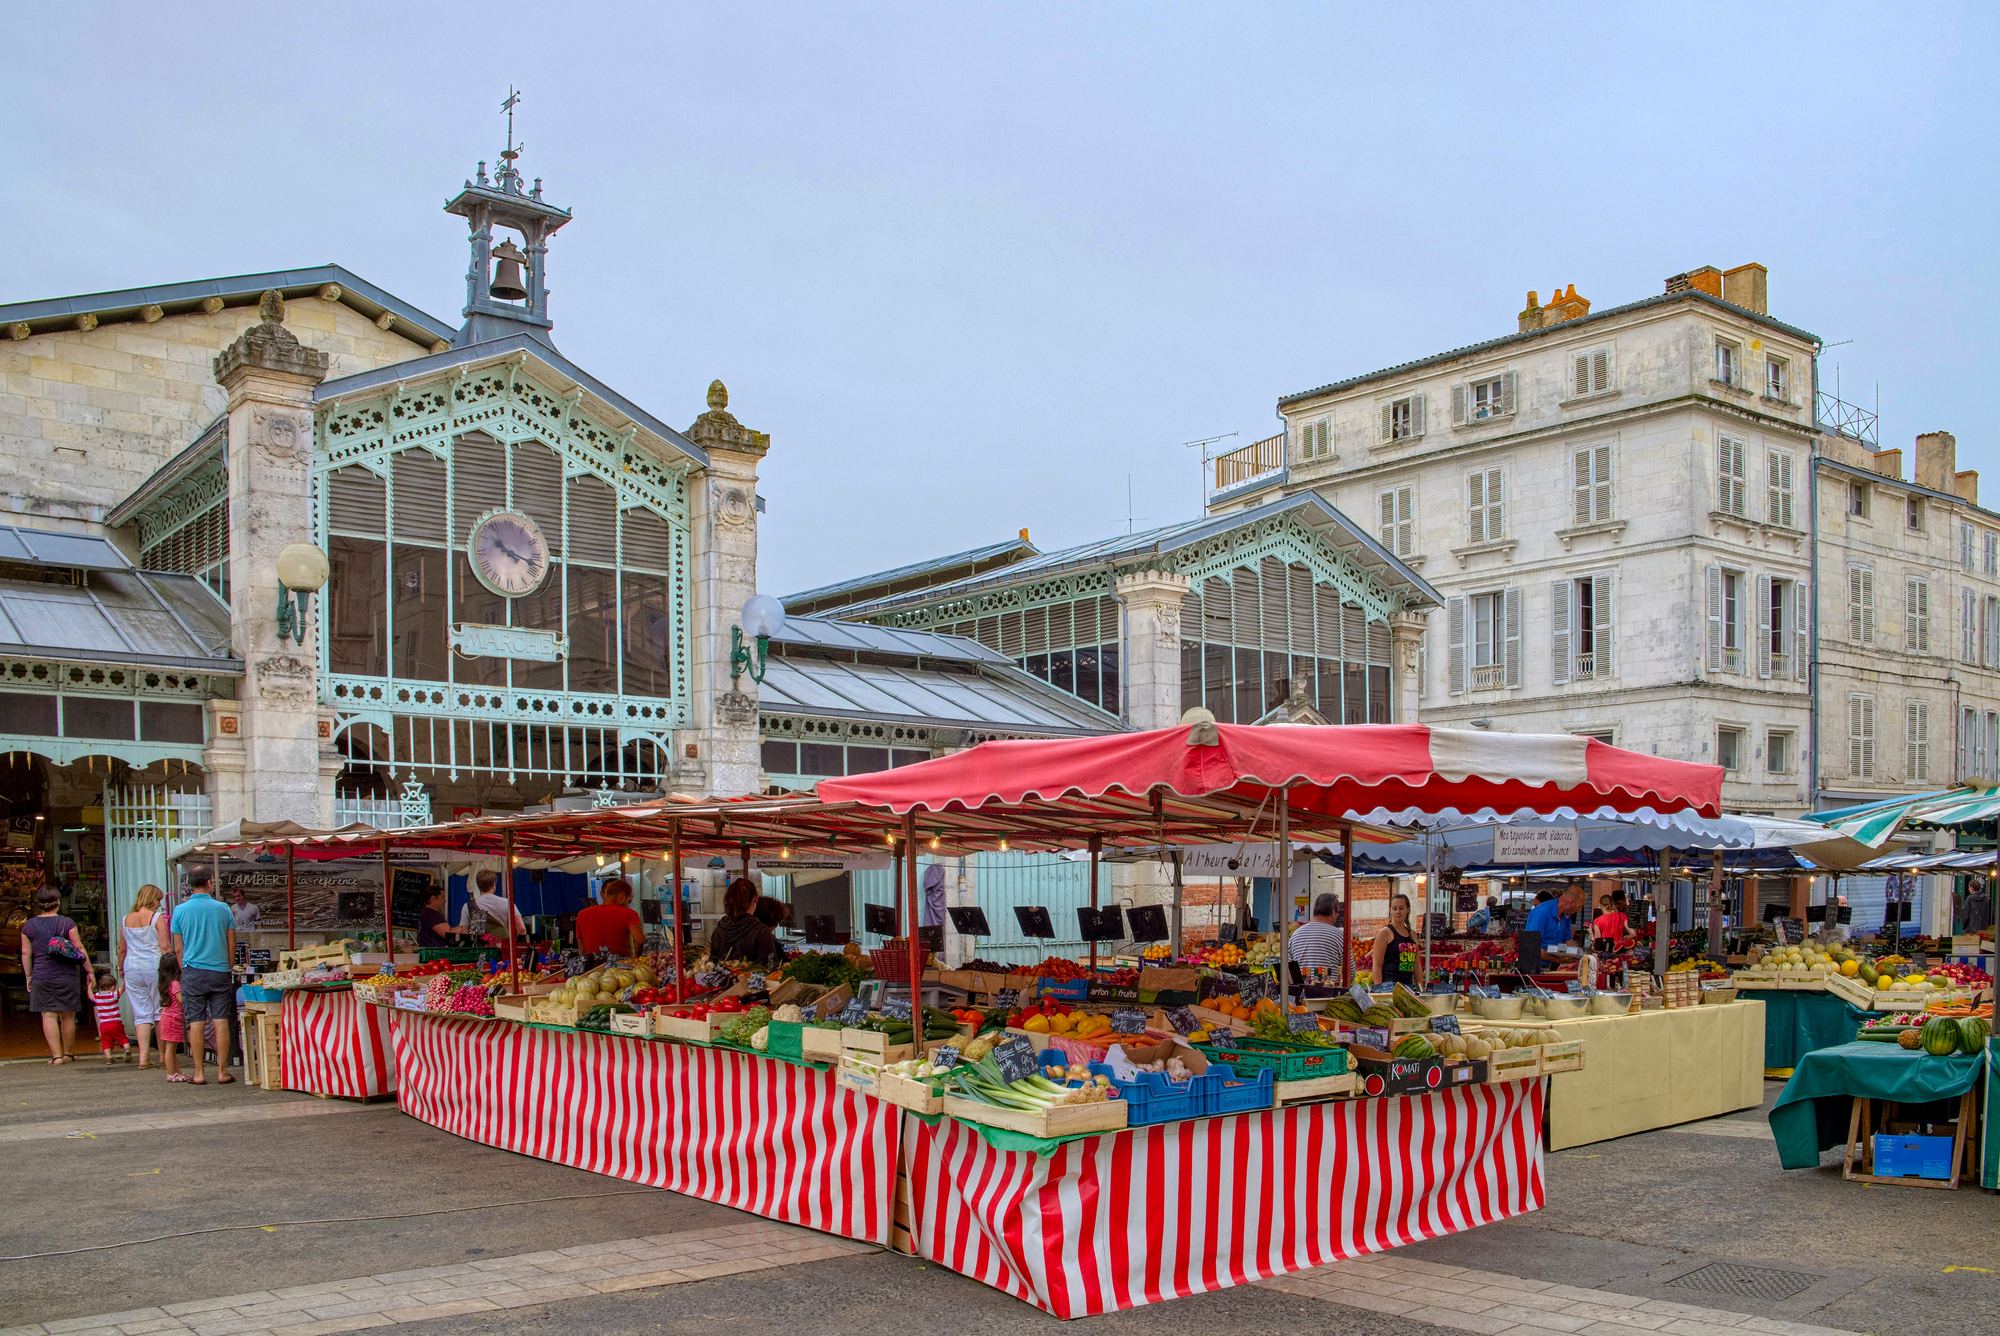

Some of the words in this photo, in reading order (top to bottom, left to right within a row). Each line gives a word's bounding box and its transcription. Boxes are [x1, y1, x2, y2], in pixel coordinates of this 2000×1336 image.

[1184, 850, 1193, 867] A
[1196, 849, 1232, 868] l'heur
[227, 873, 288, 886] LAMBERT
[296, 875, 309, 885] la
[1118, 987, 1137, 998] fruits
